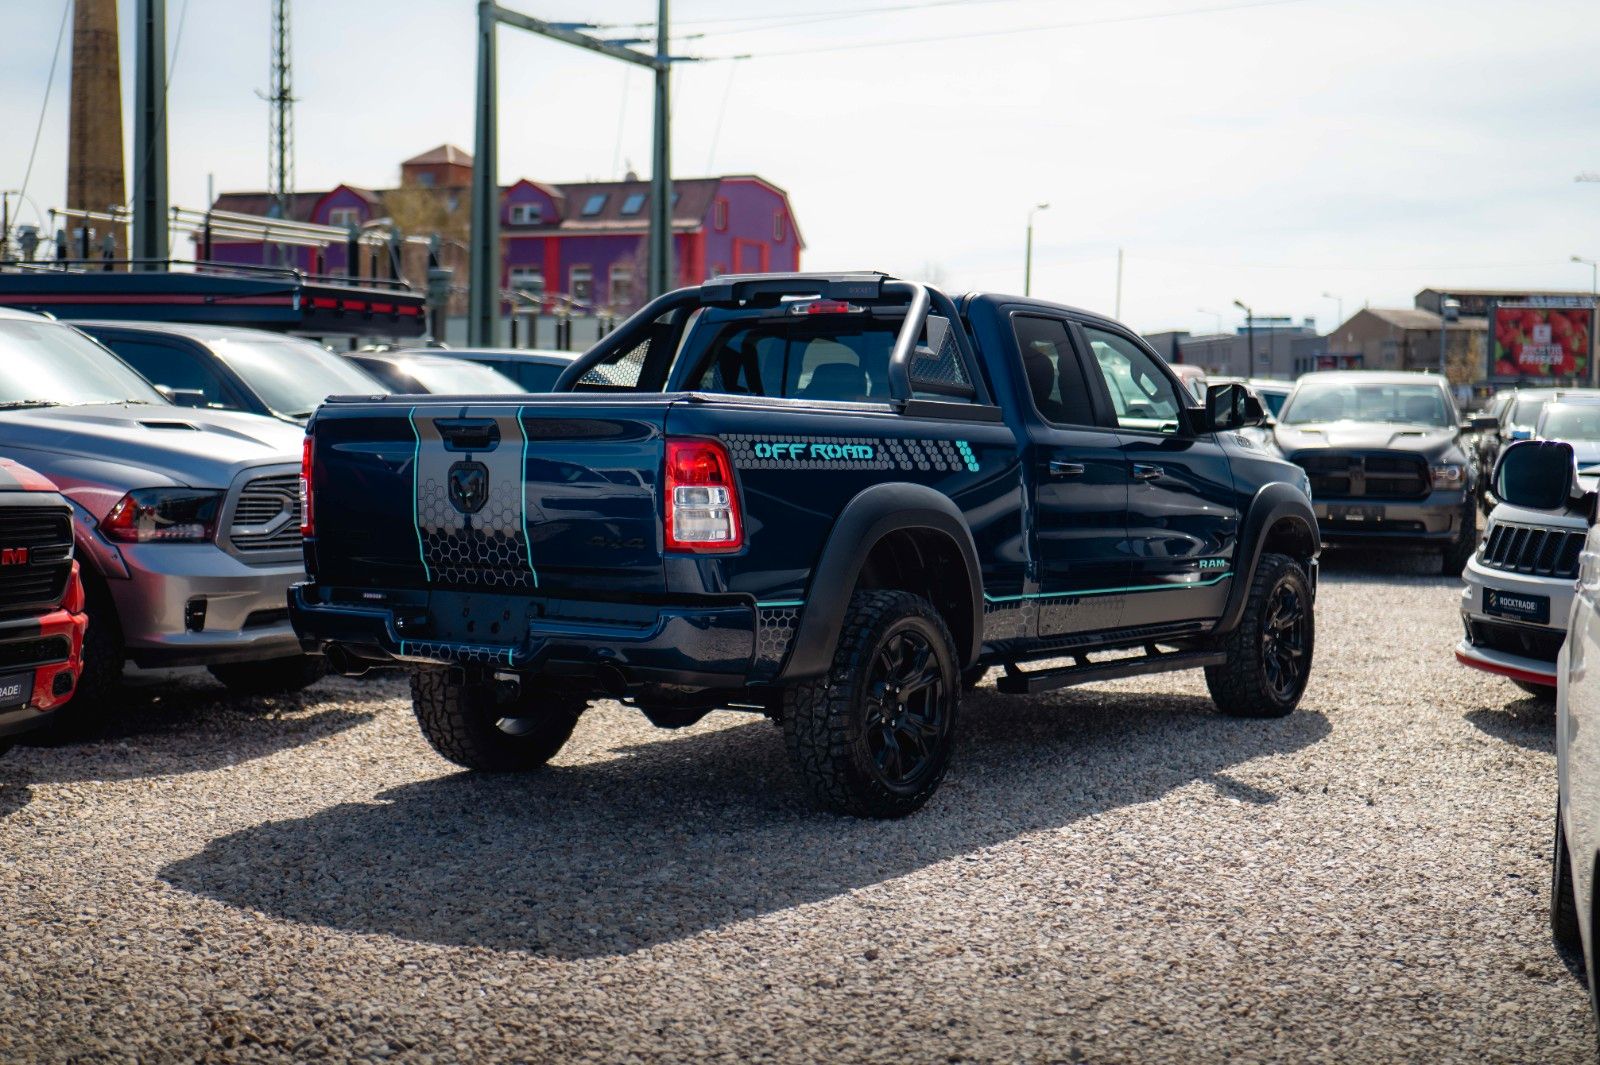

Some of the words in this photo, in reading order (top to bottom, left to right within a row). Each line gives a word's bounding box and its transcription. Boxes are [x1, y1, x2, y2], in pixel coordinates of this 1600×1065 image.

[755, 443, 807, 460] OFF
[810, 443, 873, 460] ROAD
[1199, 559, 1225, 569] RAM
[1500, 597, 1536, 610] ROCKTRADE
